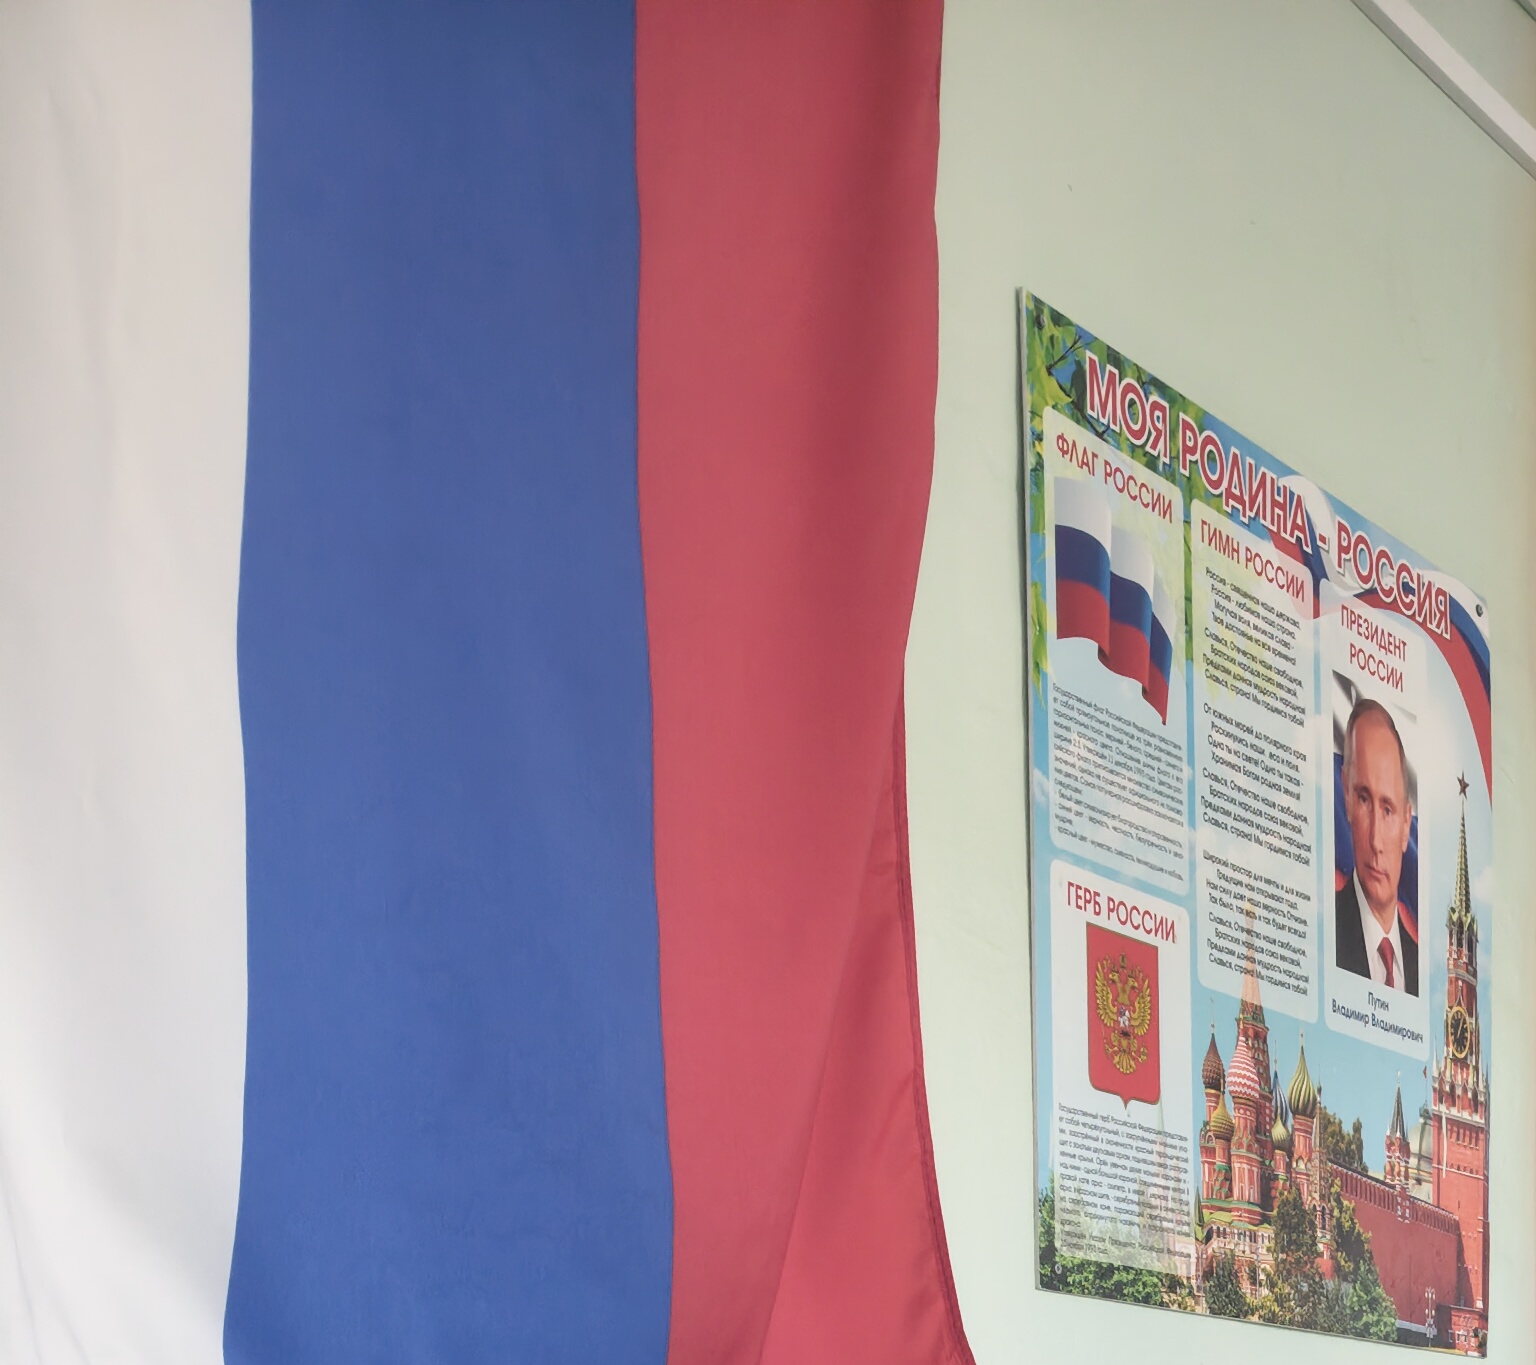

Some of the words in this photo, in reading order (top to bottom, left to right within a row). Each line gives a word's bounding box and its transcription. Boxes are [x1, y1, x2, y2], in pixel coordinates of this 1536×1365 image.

[1056, 429, 1099, 479] ФЛАГ
[1104, 458, 1173, 525] РОССИИ
[1088, 355, 1168, 460] МОЯ
[1181, 416, 1310, 558] РОДИНА
[1337, 519, 1449, 637] РОССИЯ
[1200, 517, 1240, 565] ГИМН
[1245, 545, 1304, 603] РОССИИ
[1341, 603, 1406, 666] ПРЕЗИДЕНТ
[1349, 641, 1403, 693] РОССИИ
[1067, 880, 1101, 918] ГЕРБ
[1107, 895, 1176, 945] РОССИИ
[1331, 998, 1369, 1028] Владимир
[1371, 1012, 1423, 1047] Владимирович
[1367, 990, 1389, 1016] Путин
